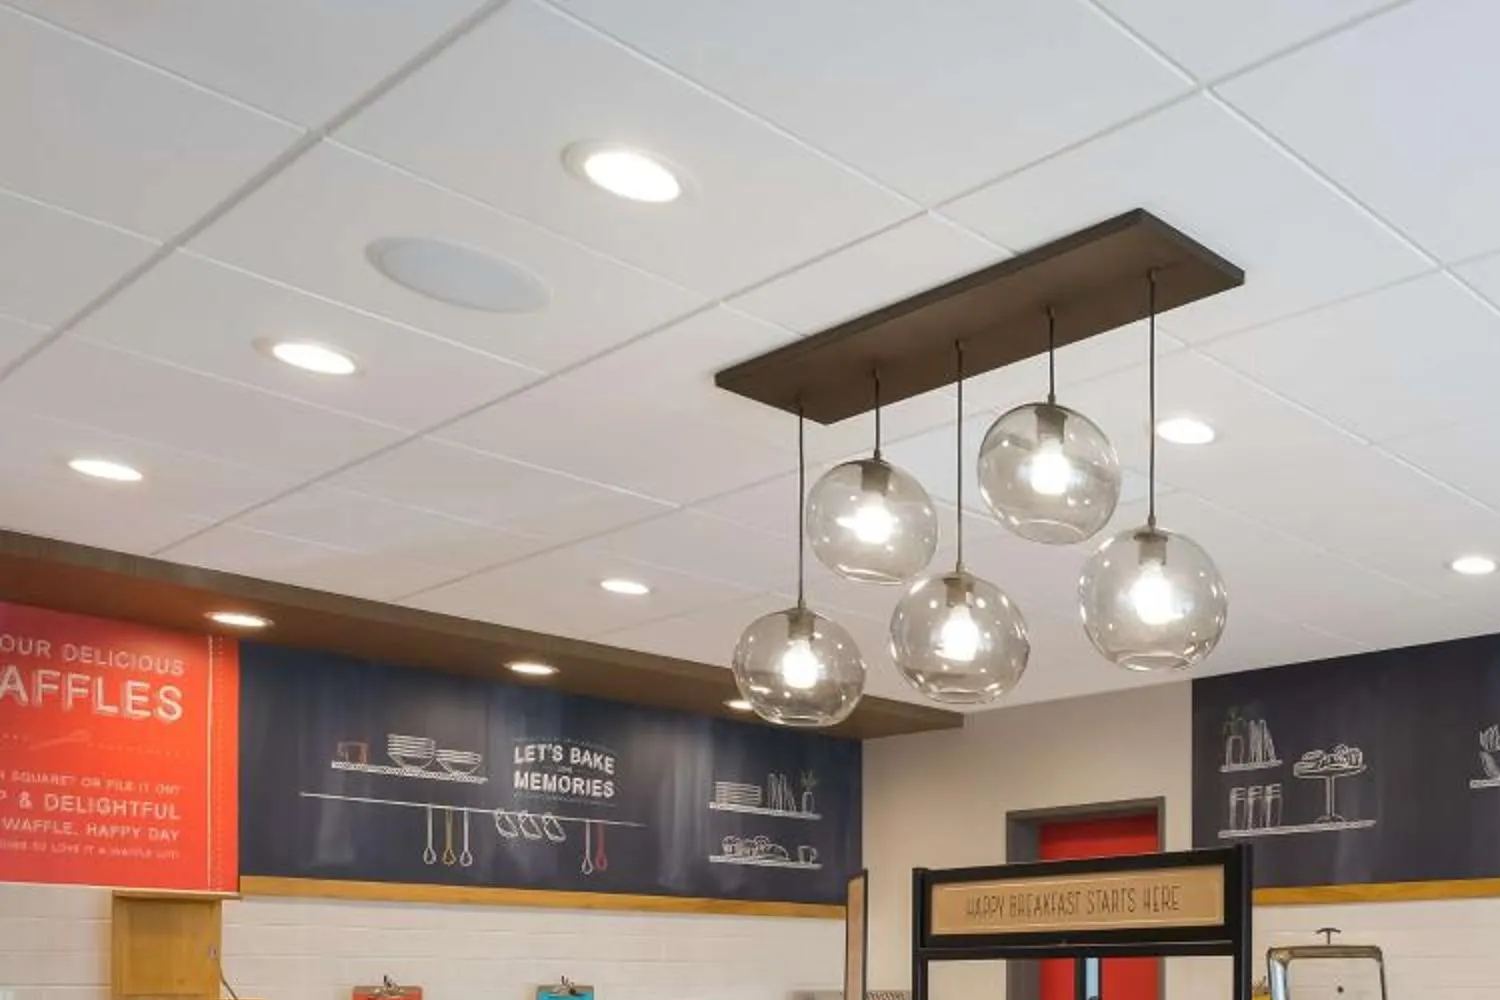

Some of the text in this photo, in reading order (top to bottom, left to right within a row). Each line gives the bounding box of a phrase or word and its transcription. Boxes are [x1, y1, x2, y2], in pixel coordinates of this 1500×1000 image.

[62, 642, 185, 678] DELICIOUS
[514, 743, 616, 776] LET'S BAKE
[513, 770, 616, 799] MEMORIES
[18, 791, 33, 810] &
[44, 793, 181, 821] DELIGHTFUL
[86, 822, 141, 840] HAPPY
[148, 827, 180, 842] DAY
[967, 884, 1182, 919] HAPPY BREAKFAST STARTS HERE
